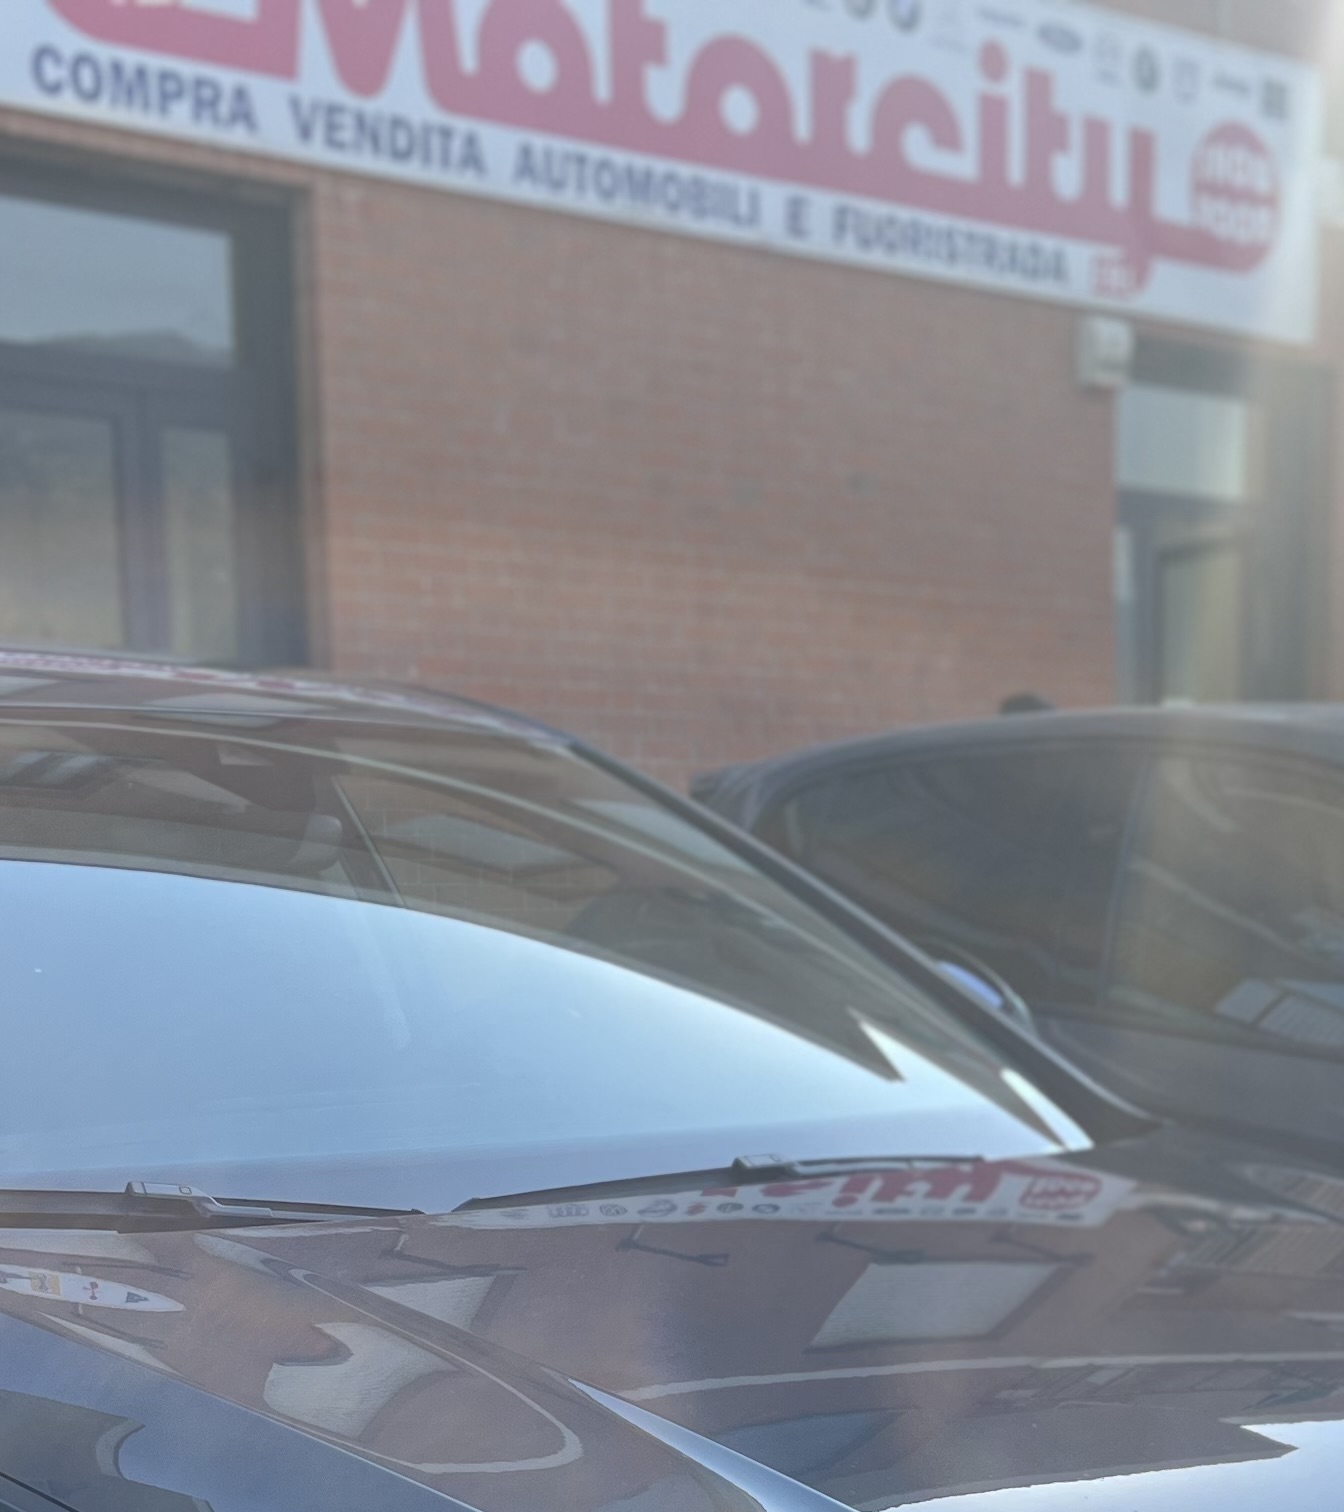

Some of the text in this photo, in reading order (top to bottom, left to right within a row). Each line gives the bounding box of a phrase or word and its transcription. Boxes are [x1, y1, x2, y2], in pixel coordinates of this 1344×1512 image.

[32, 44, 259, 136] COMPRA
[288, 93, 488, 179] VENDITA
[512, 142, 763, 231] AUTOMOBILI
[785, 194, 812, 239] E
[833, 201, 1070, 286] FUORISTRADA
